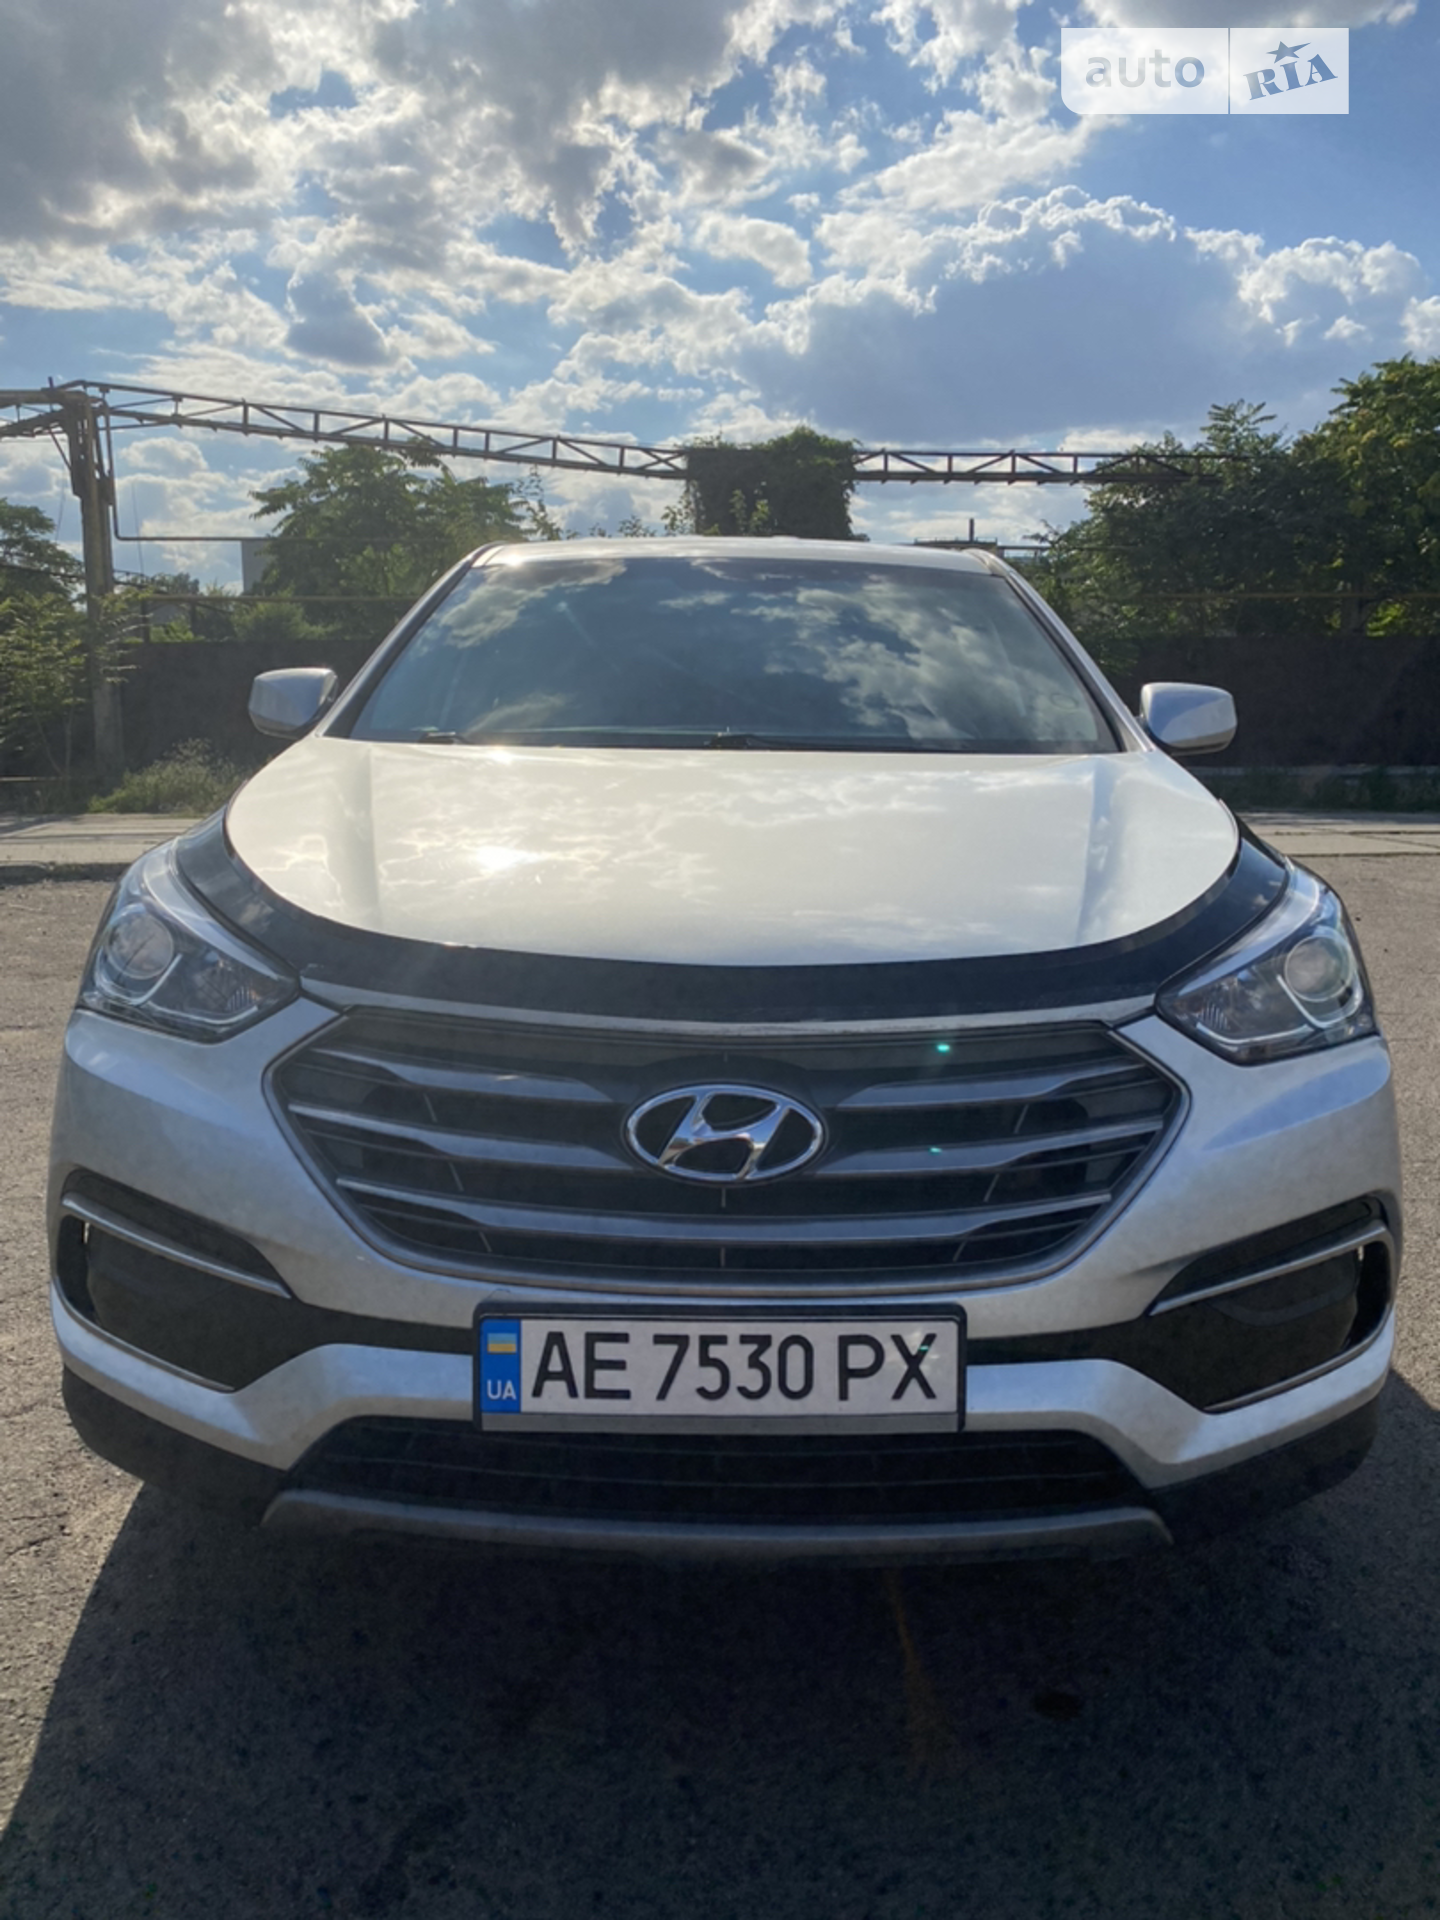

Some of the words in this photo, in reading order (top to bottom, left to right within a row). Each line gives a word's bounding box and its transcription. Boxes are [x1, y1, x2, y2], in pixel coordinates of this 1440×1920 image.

[531, 1331, 631, 1400] AE
[652, 1333, 814, 1400] 7530
[838, 1333, 937, 1401] PX
[487, 1379, 517, 1400] UA
